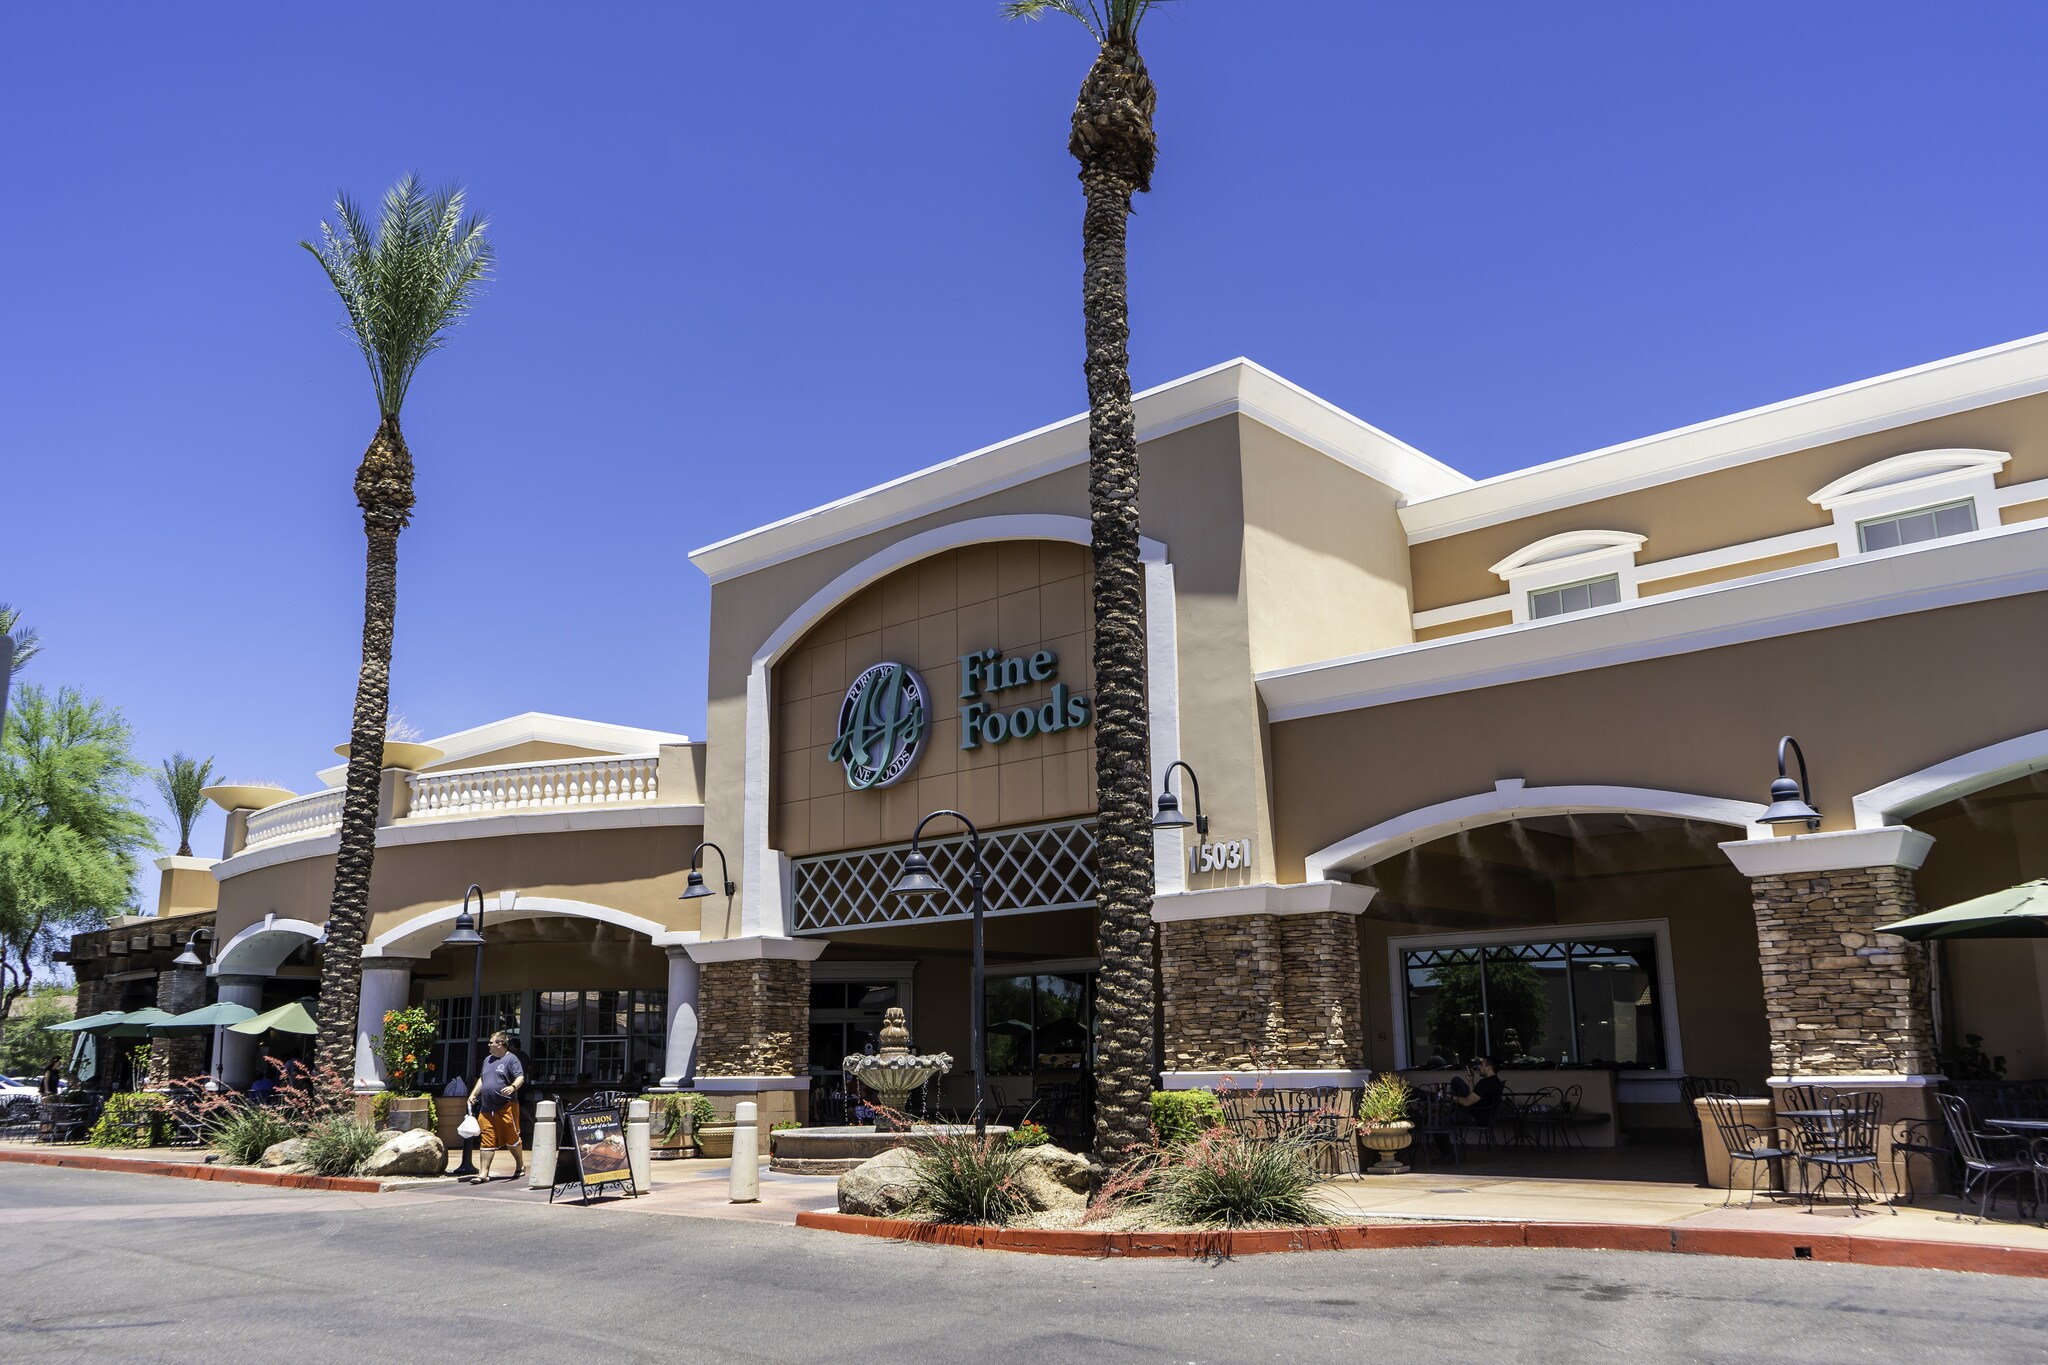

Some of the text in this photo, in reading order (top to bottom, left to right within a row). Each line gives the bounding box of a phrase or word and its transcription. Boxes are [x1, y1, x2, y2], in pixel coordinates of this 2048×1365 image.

[957, 648, 1058, 699] Fine
[907, 684, 920, 702] OF
[958, 683, 1092, 750] Foods
[1187, 838, 1251, 874] 15031
[580, 1115, 612, 1125] SALMON
[587, 1174, 605, 1182] FRESH
